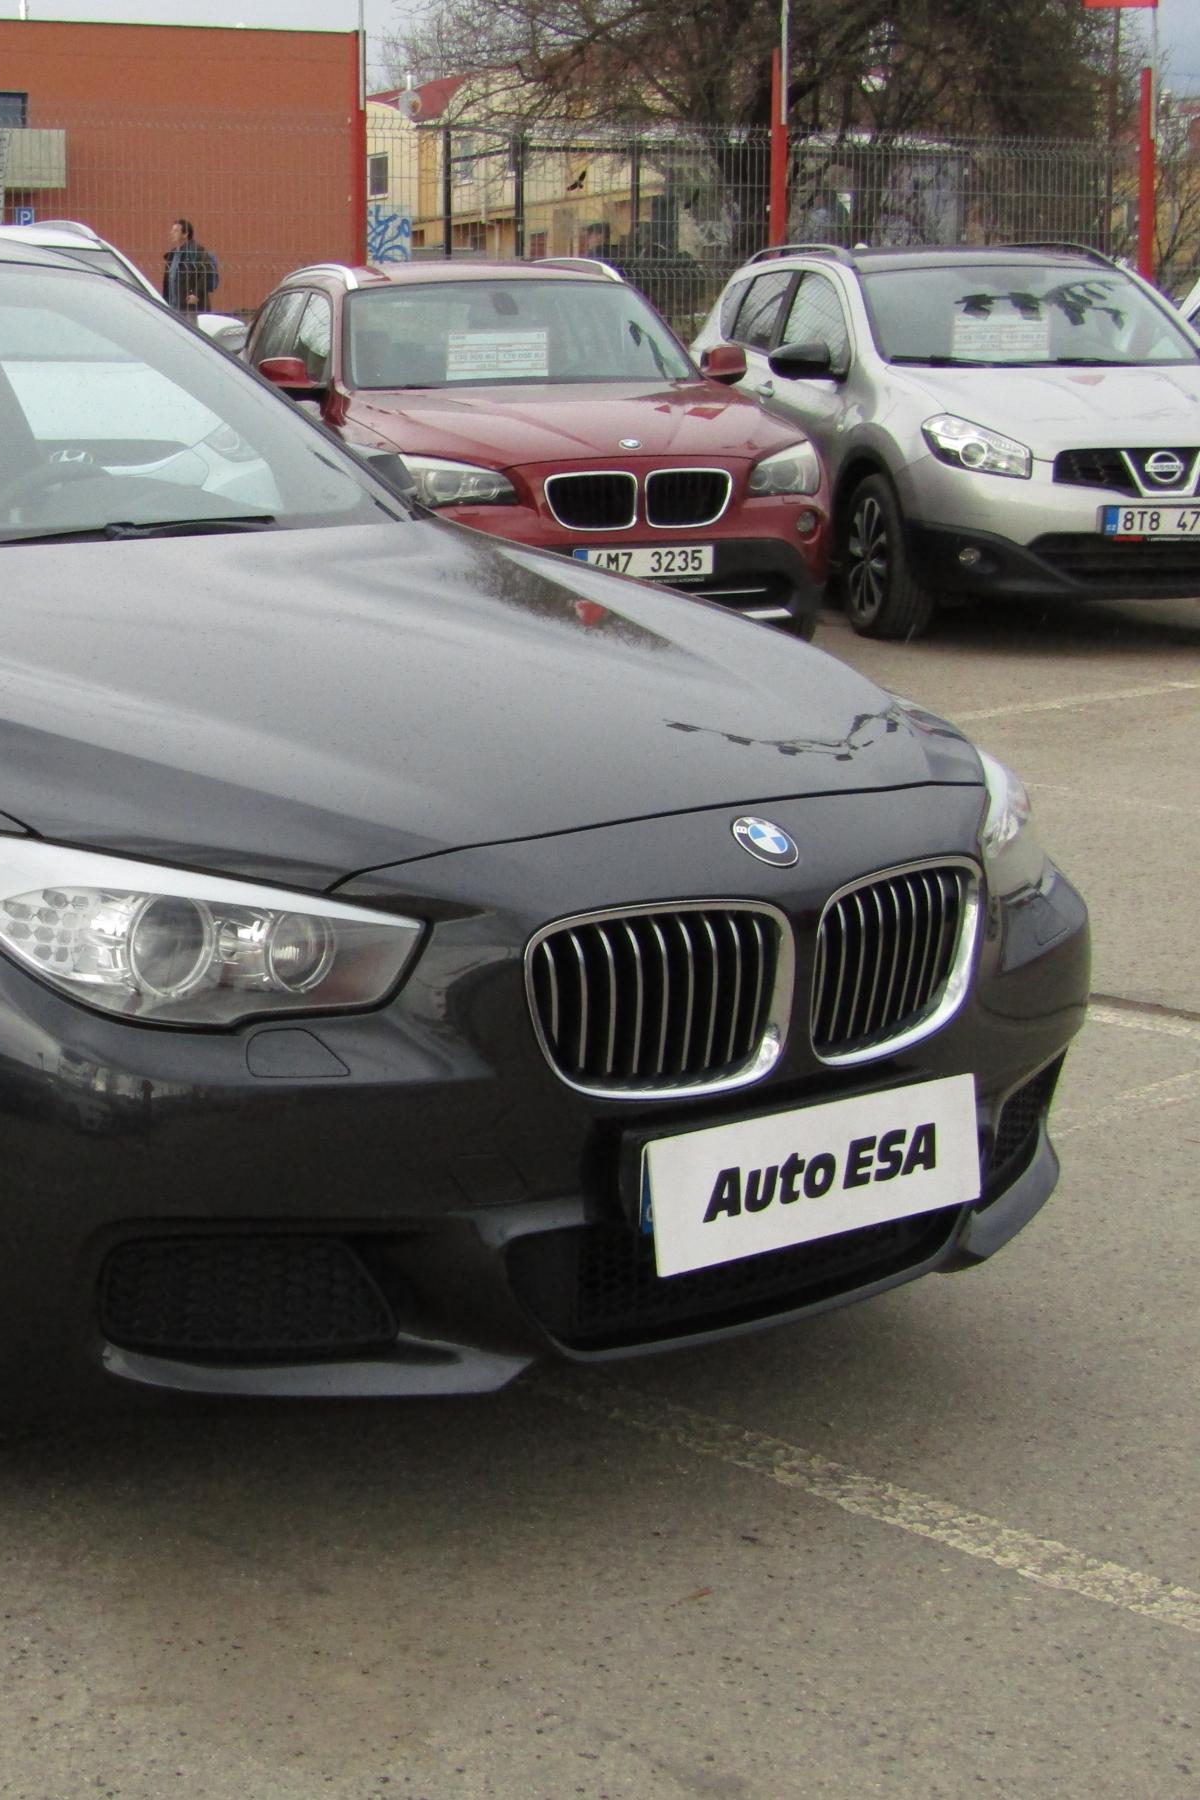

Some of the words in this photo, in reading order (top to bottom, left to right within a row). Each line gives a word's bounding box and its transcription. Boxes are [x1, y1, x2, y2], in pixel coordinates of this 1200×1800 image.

[20, 210, 31, 225] P
[1123, 511, 1161, 531] 8T8
[650, 549, 703, 573] 3235
[702, 1152, 836, 1223] Auto
[842, 1122, 937, 1190] ESA
